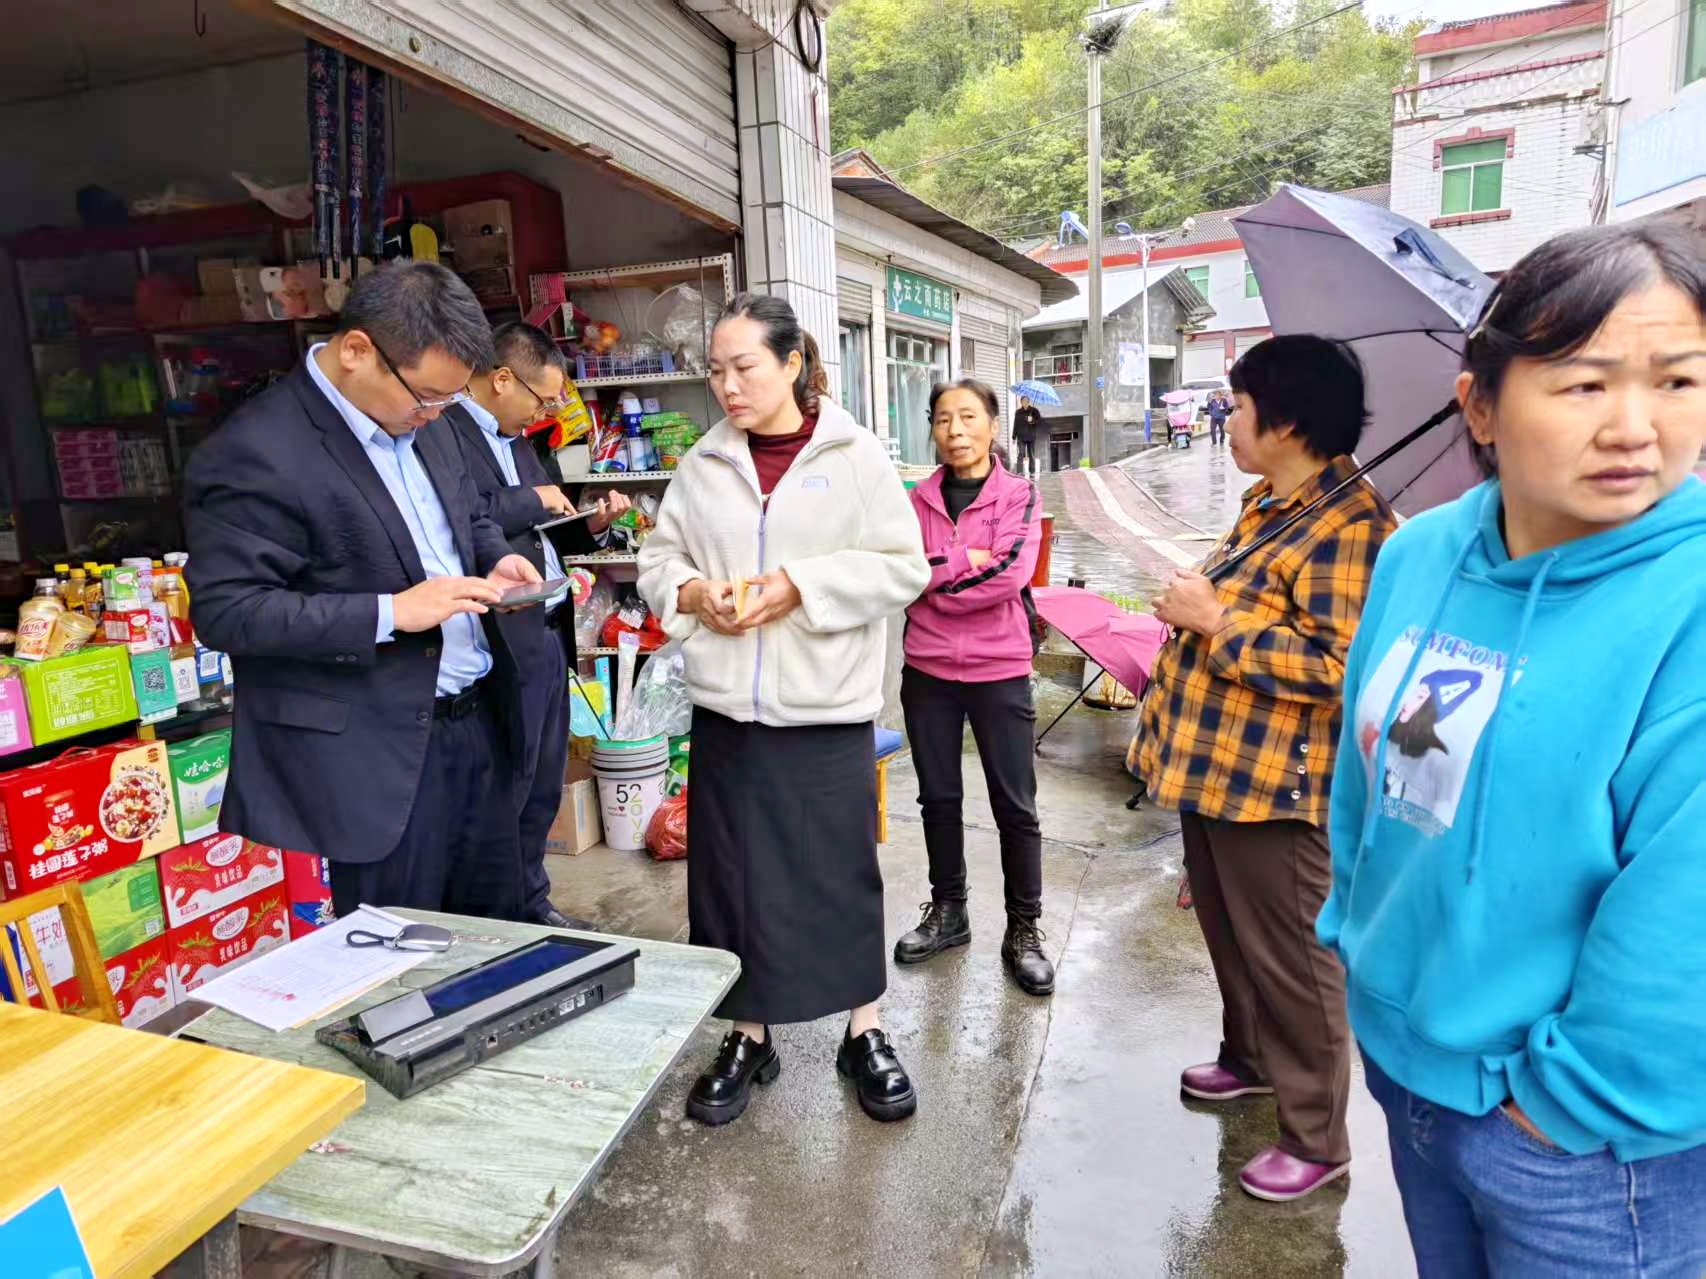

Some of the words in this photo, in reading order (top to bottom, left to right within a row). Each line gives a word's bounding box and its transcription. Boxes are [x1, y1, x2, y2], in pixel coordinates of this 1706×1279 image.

[183, 756, 224, 777] 娃哈哈
[29, 838, 108, 880] 桂圆莲子粥
